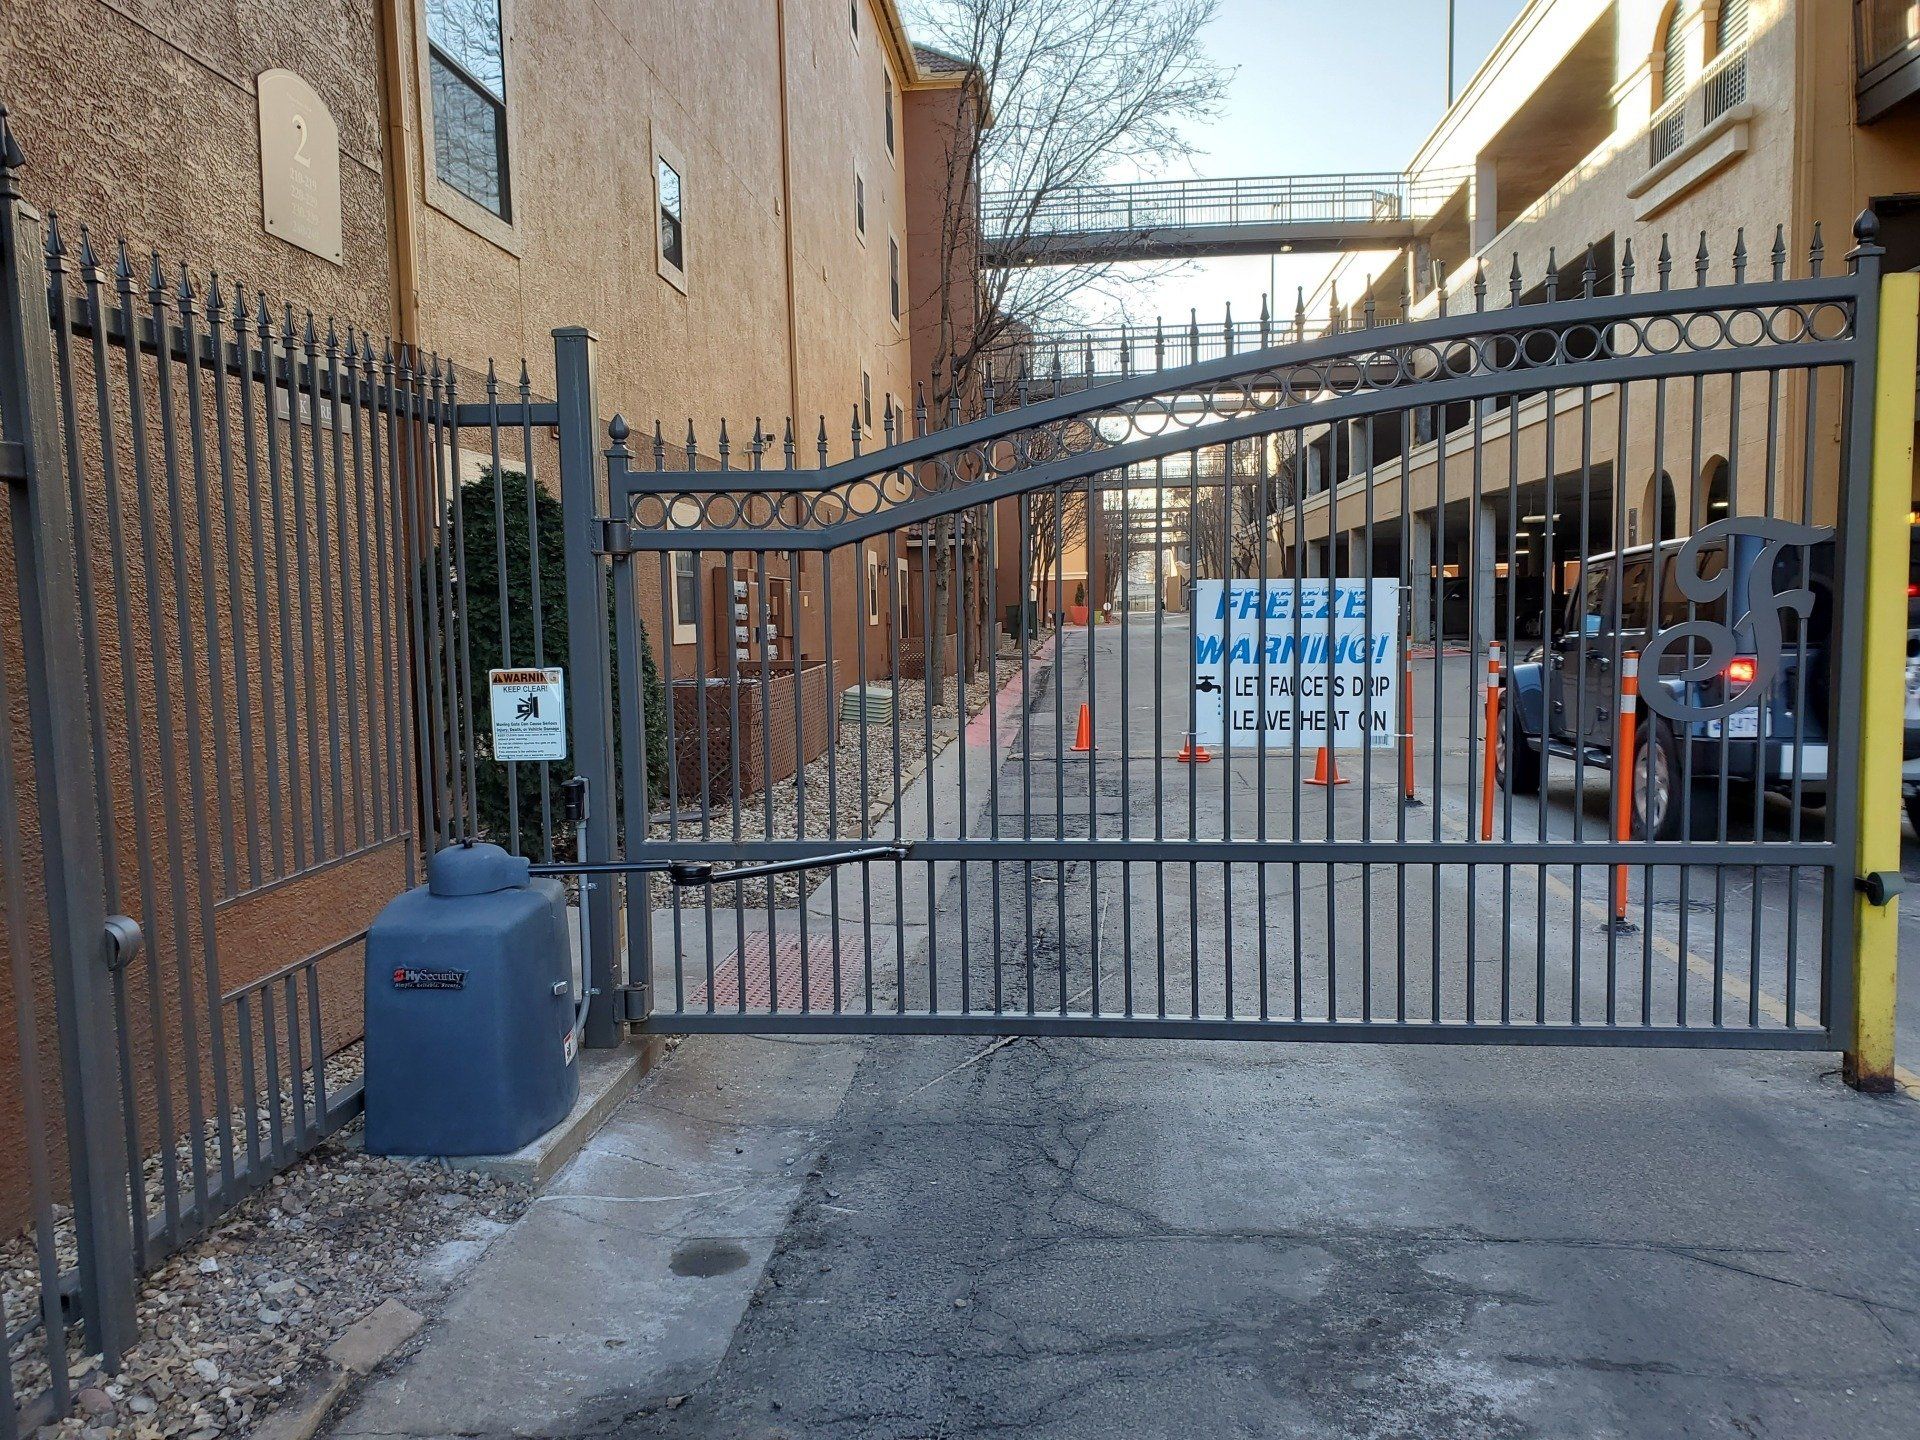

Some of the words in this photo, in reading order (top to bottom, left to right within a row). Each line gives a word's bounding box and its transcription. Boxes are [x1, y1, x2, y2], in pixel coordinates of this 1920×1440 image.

[292, 114, 311, 168] 2
[1215, 587, 1369, 619] FREEZE
[1196, 632, 1391, 665] WARNING!
[503, 673, 548, 683] WARNIN
[1236, 676, 1263, 697] LET
[1270, 675, 1345, 697] FAUCES
[1352, 676, 1390, 697] DRIP
[503, 685, 521, 693] KEEP
[523, 685, 548, 693] CLEAR!
[1300, 710, 1350, 731] HEAT
[1358, 710, 1387, 731] ON
[405, 969, 462, 983] HySecurity
